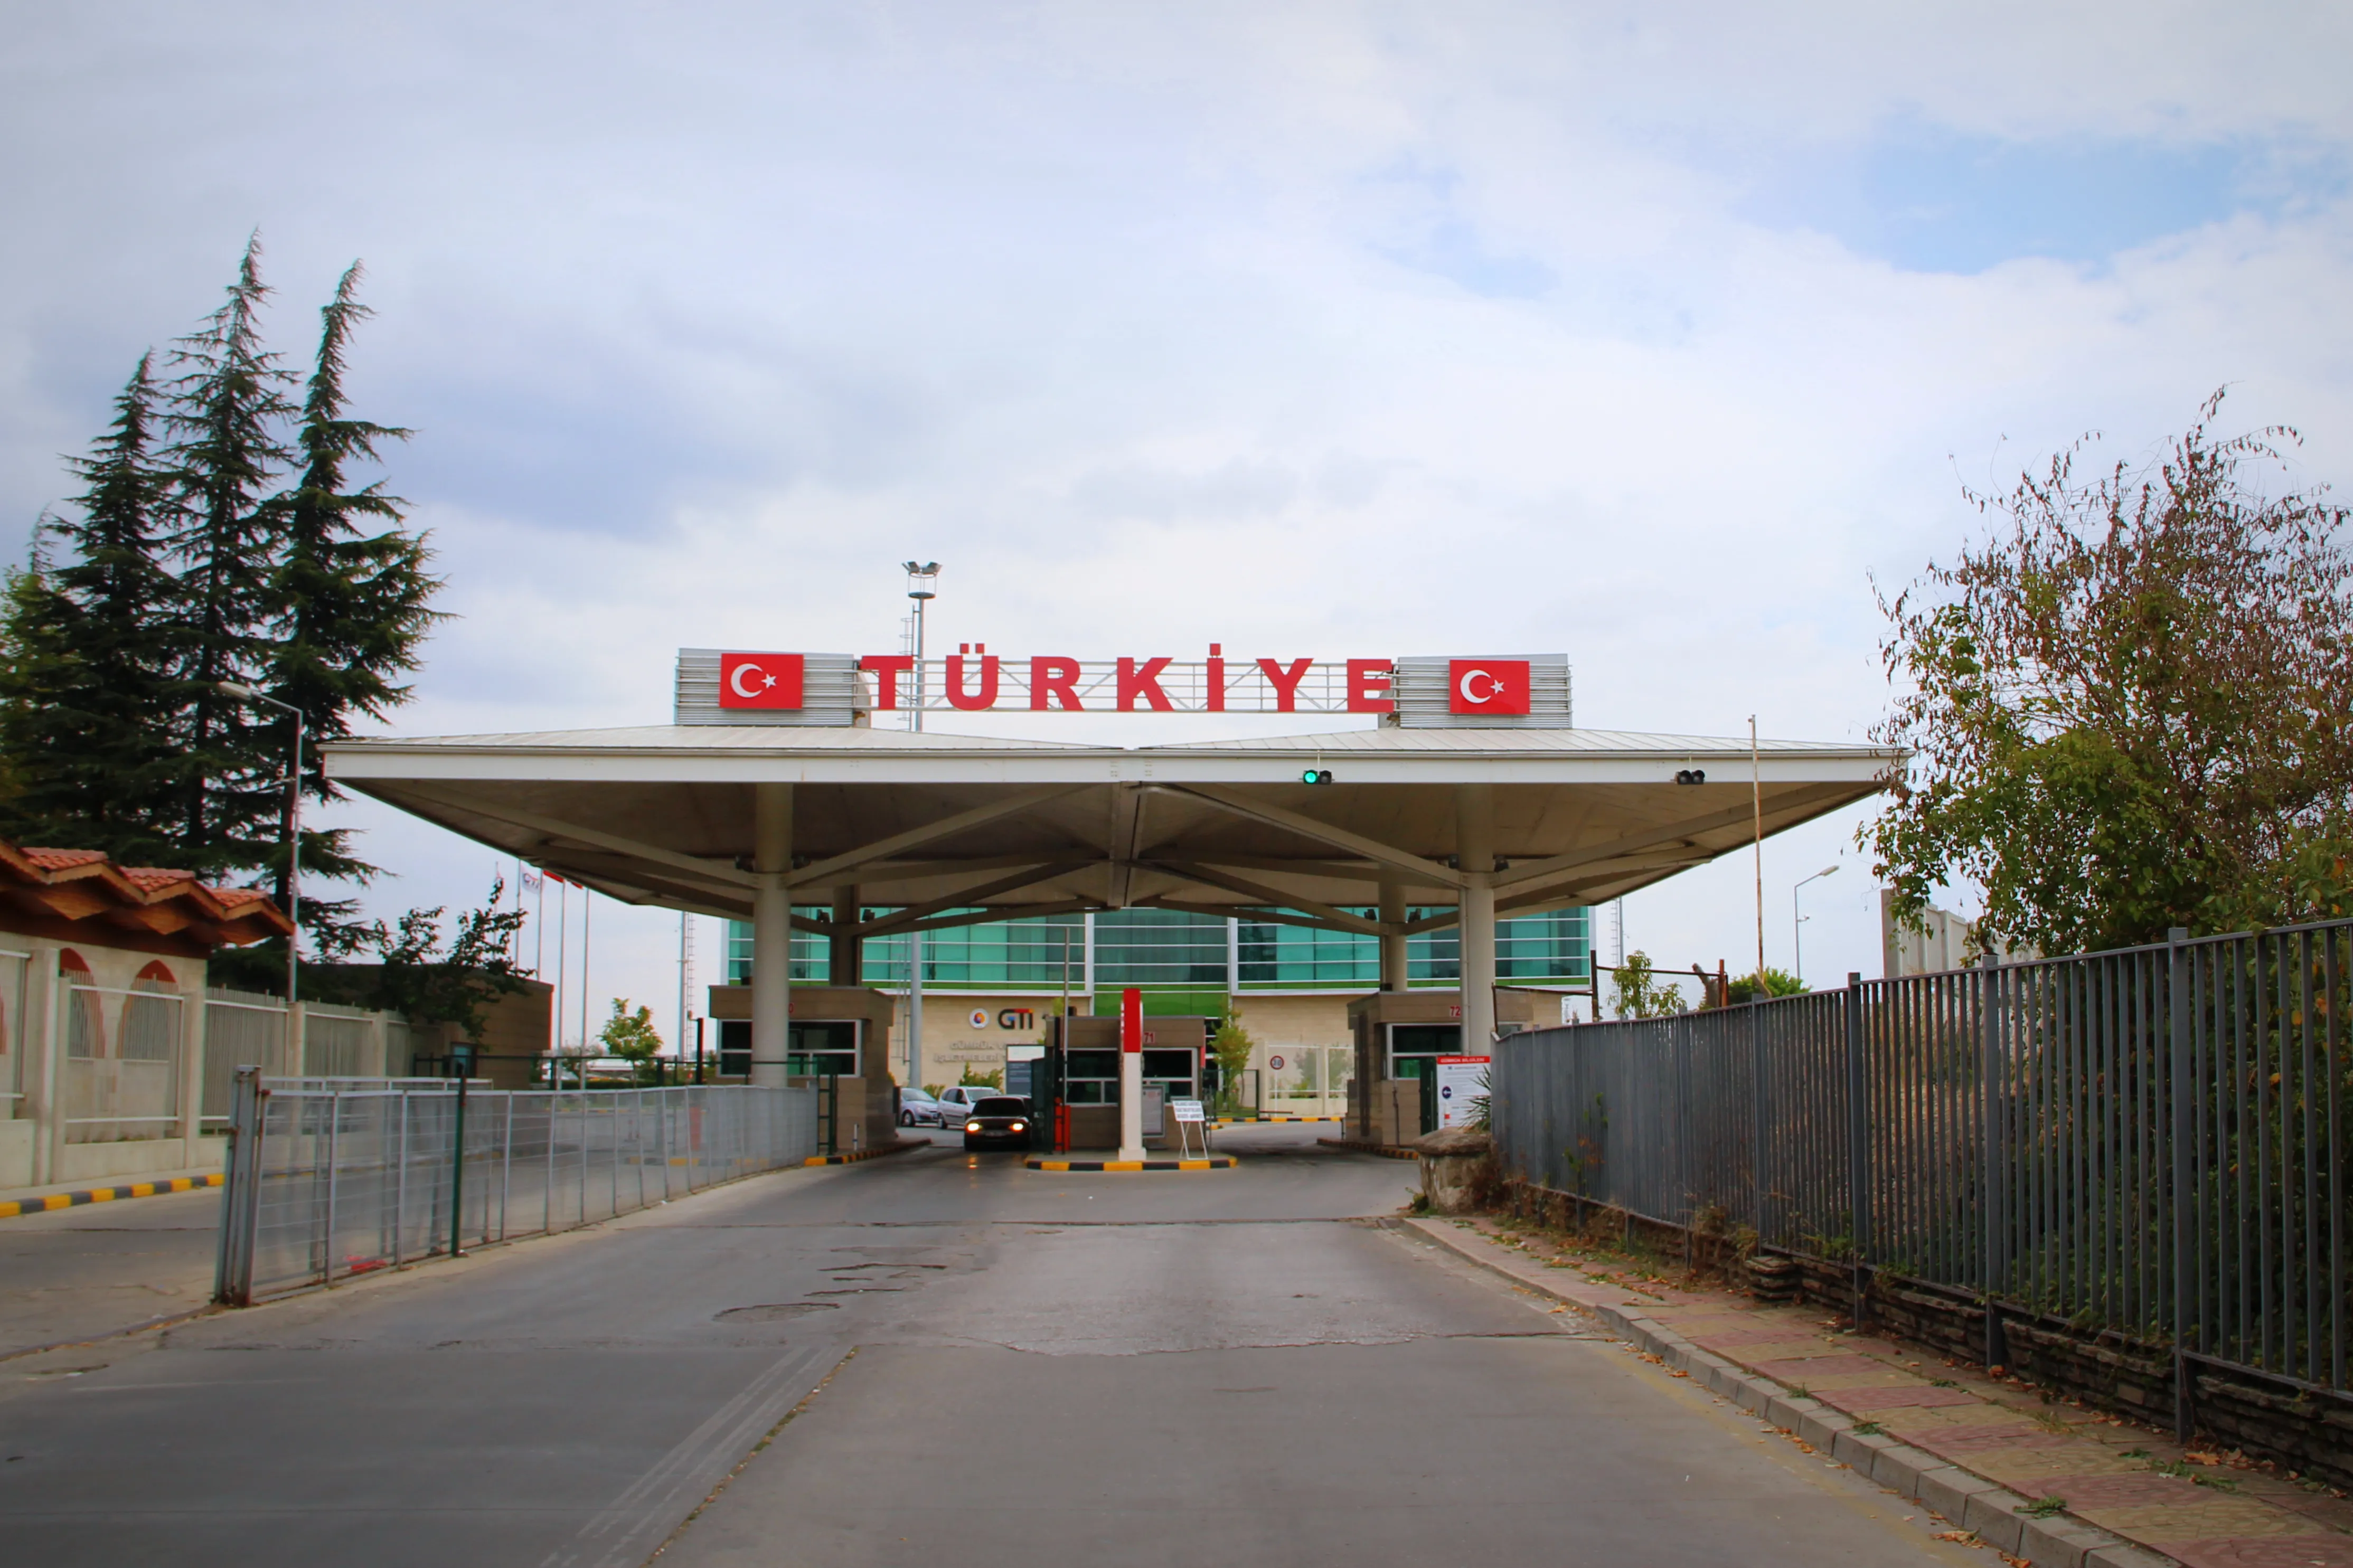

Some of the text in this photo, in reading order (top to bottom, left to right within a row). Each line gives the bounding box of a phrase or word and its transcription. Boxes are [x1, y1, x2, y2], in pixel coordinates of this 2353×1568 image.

[860, 643, 1394, 713] TÜRKİYE
[1450, 1006, 1461, 1016] 72
[1144, 1032, 1154, 1043] 71
